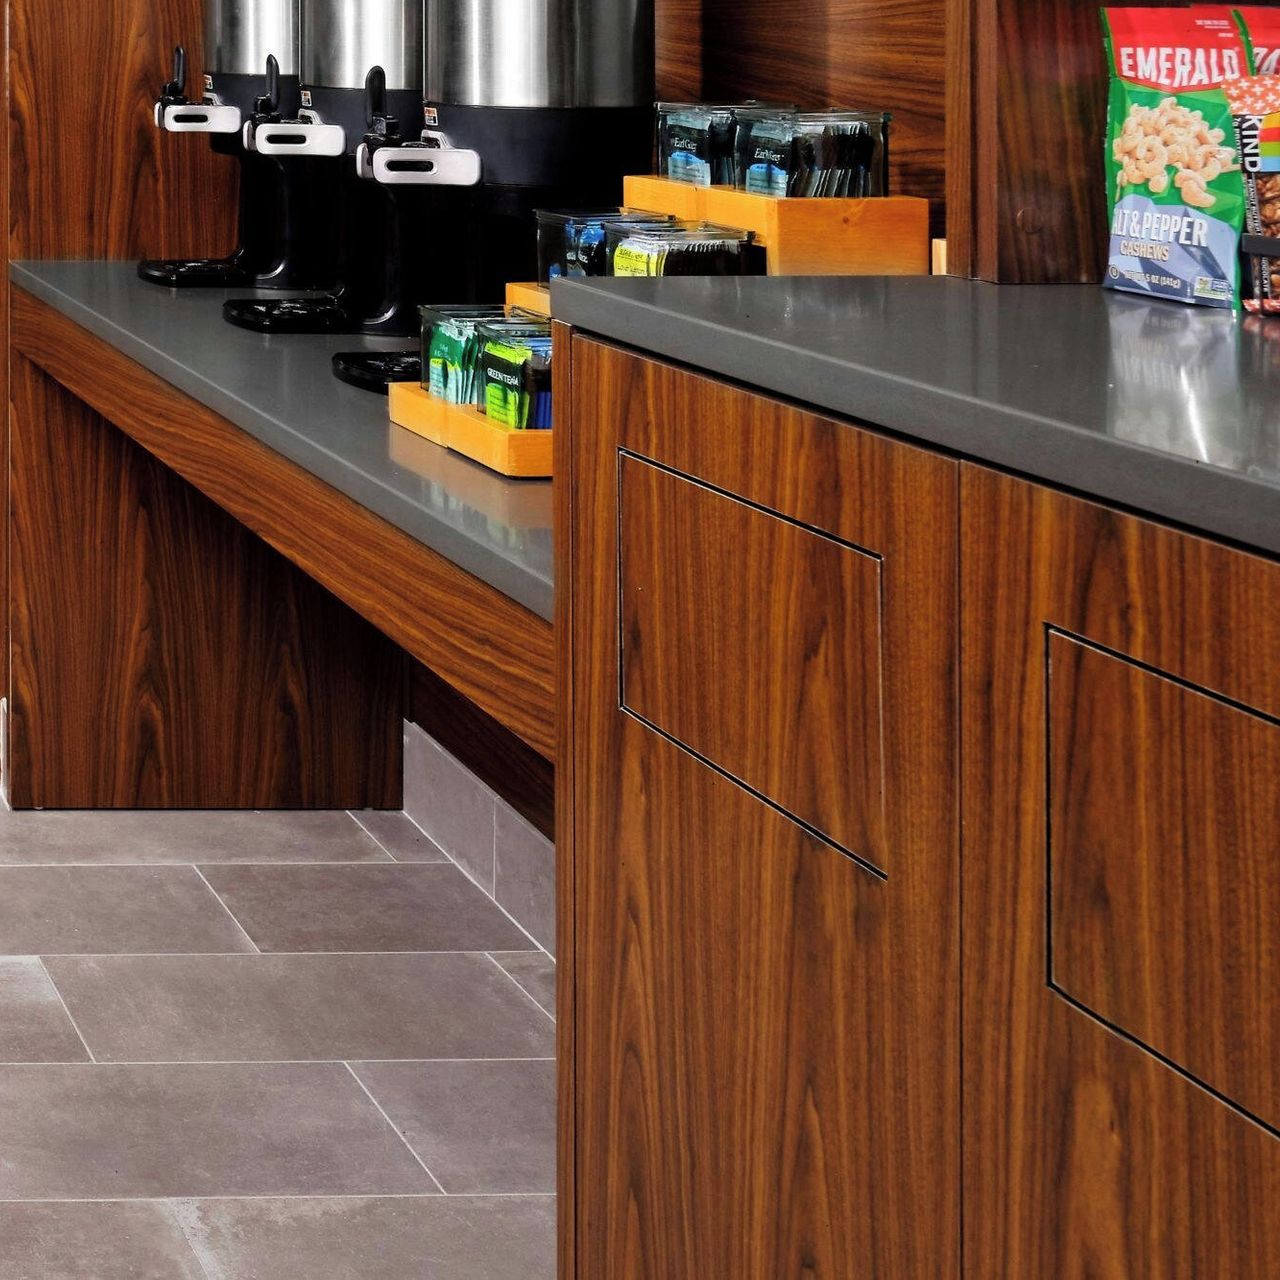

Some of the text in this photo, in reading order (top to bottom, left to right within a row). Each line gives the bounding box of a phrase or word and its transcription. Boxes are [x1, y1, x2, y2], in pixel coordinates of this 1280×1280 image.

[1120, 46, 1240, 89] EMERALD
[1242, 114, 1261, 173] KIND
[1129, 209, 1140, 239] &
[1141, 211, 1208, 247] PEPPER
[1120, 239, 1170, 262] CASHEWS
[487, 367, 504, 383] GREEN
